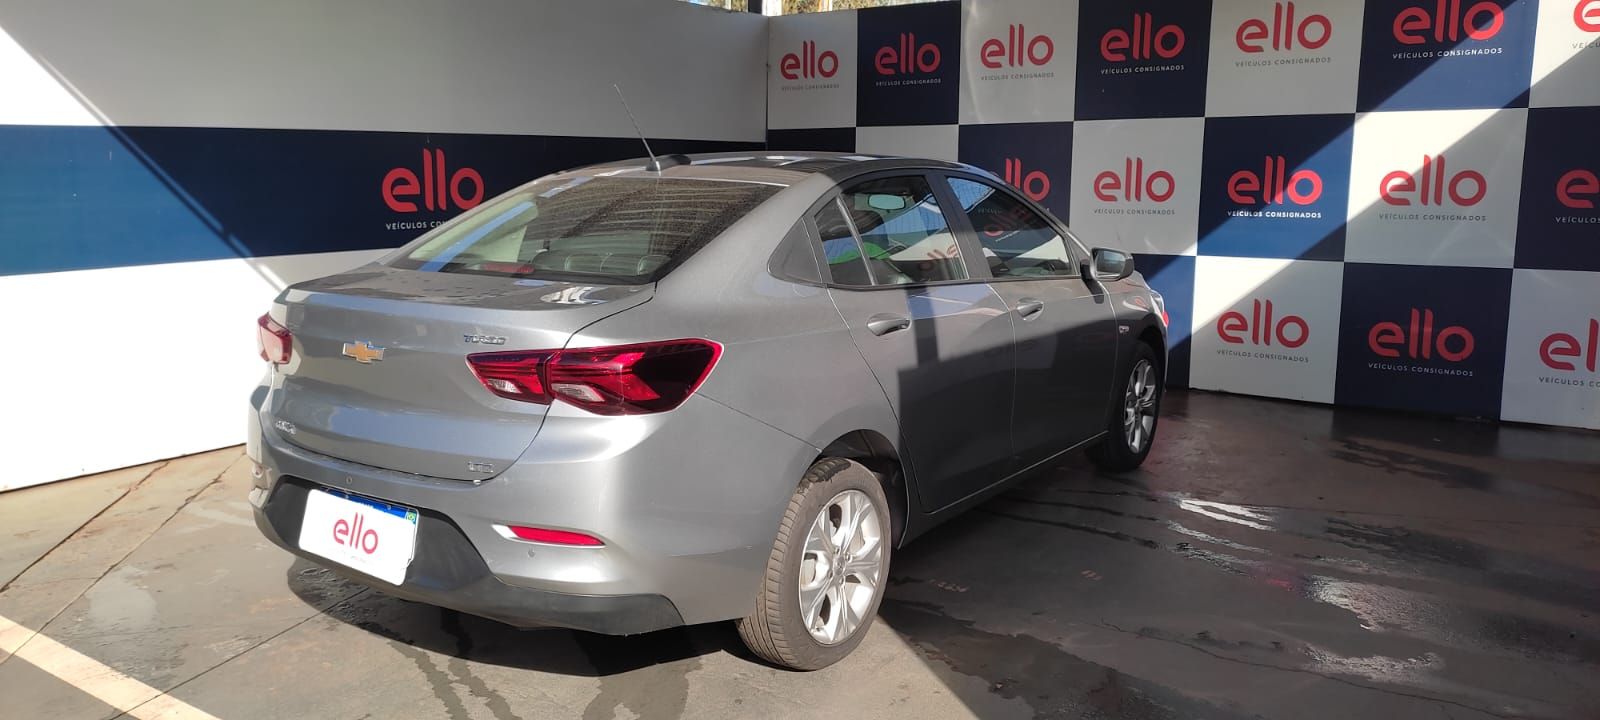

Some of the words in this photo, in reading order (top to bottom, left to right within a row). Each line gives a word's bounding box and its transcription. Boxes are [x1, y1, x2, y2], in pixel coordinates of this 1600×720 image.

[1101, 12, 1185, 62] ello
[1235, 1, 1332, 53] ello
[1393, 0, 1504, 45] ello
[780, 40, 839, 80] ello
[875, 32, 941, 75] ello
[980, 24, 1054, 69] ello
[1274, 57, 1331, 66] CONSIGNADOS
[1437, 47, 1503, 57] CONSIGNADOS
[1134, 65, 1185, 73] CONSIGNADOS
[382, 148, 485, 213] ello
[991, 157, 1050, 202] llo
[1093, 156, 1176, 203] ello
[1227, 155, 1323, 206] ello
[1379, 154, 1488, 207] ello
[385, 221, 427, 231] VEÍCULOS
[1127, 208, 1175, 216] CONSIGNADOS
[1265, 210, 1322, 219] CONSIGNADOS
[1422, 213, 1487, 222] CONSIGNADOS
[1216, 298, 1310, 349] ello
[1368, 307, 1475, 363] ello
[1254, 352, 1309, 363] CONSIGNADOS
[1411, 366, 1474, 377] CONSIGNADOS
